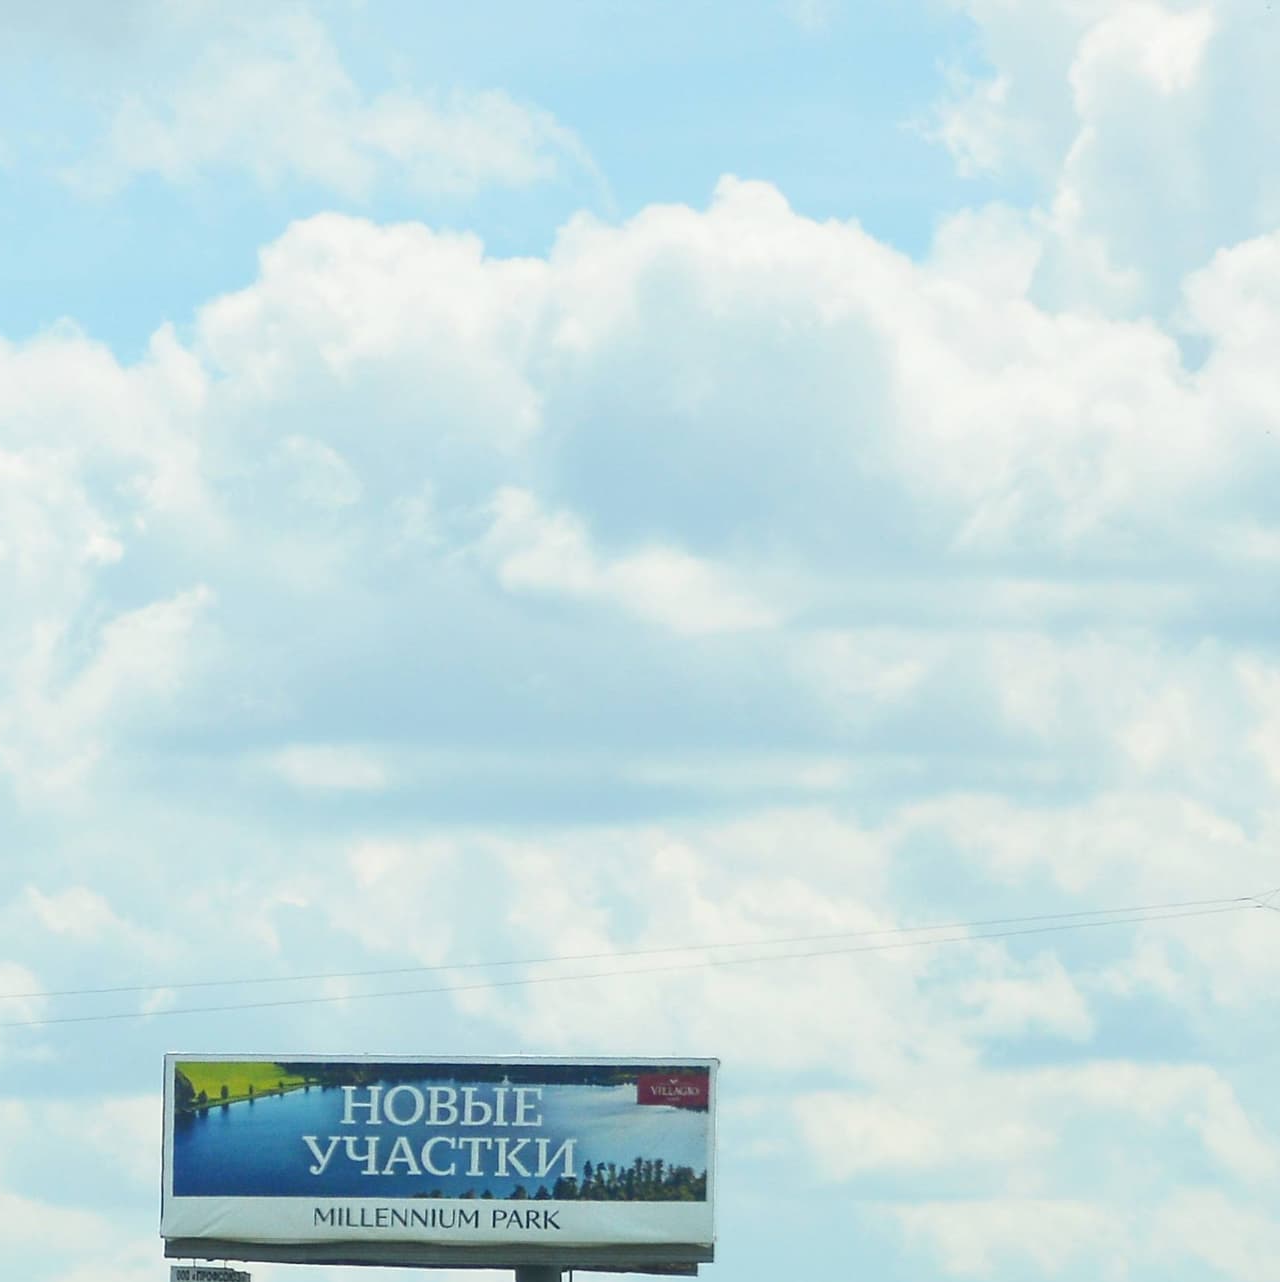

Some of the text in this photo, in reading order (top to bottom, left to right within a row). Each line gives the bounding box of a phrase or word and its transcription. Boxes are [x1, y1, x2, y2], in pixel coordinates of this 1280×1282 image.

[340, 1085, 543, 1127] НОВЫЕ
[302, 1136, 578, 1178] УЧАСТКИ
[313, 1207, 562, 1231] MILLENNIUM PARK
